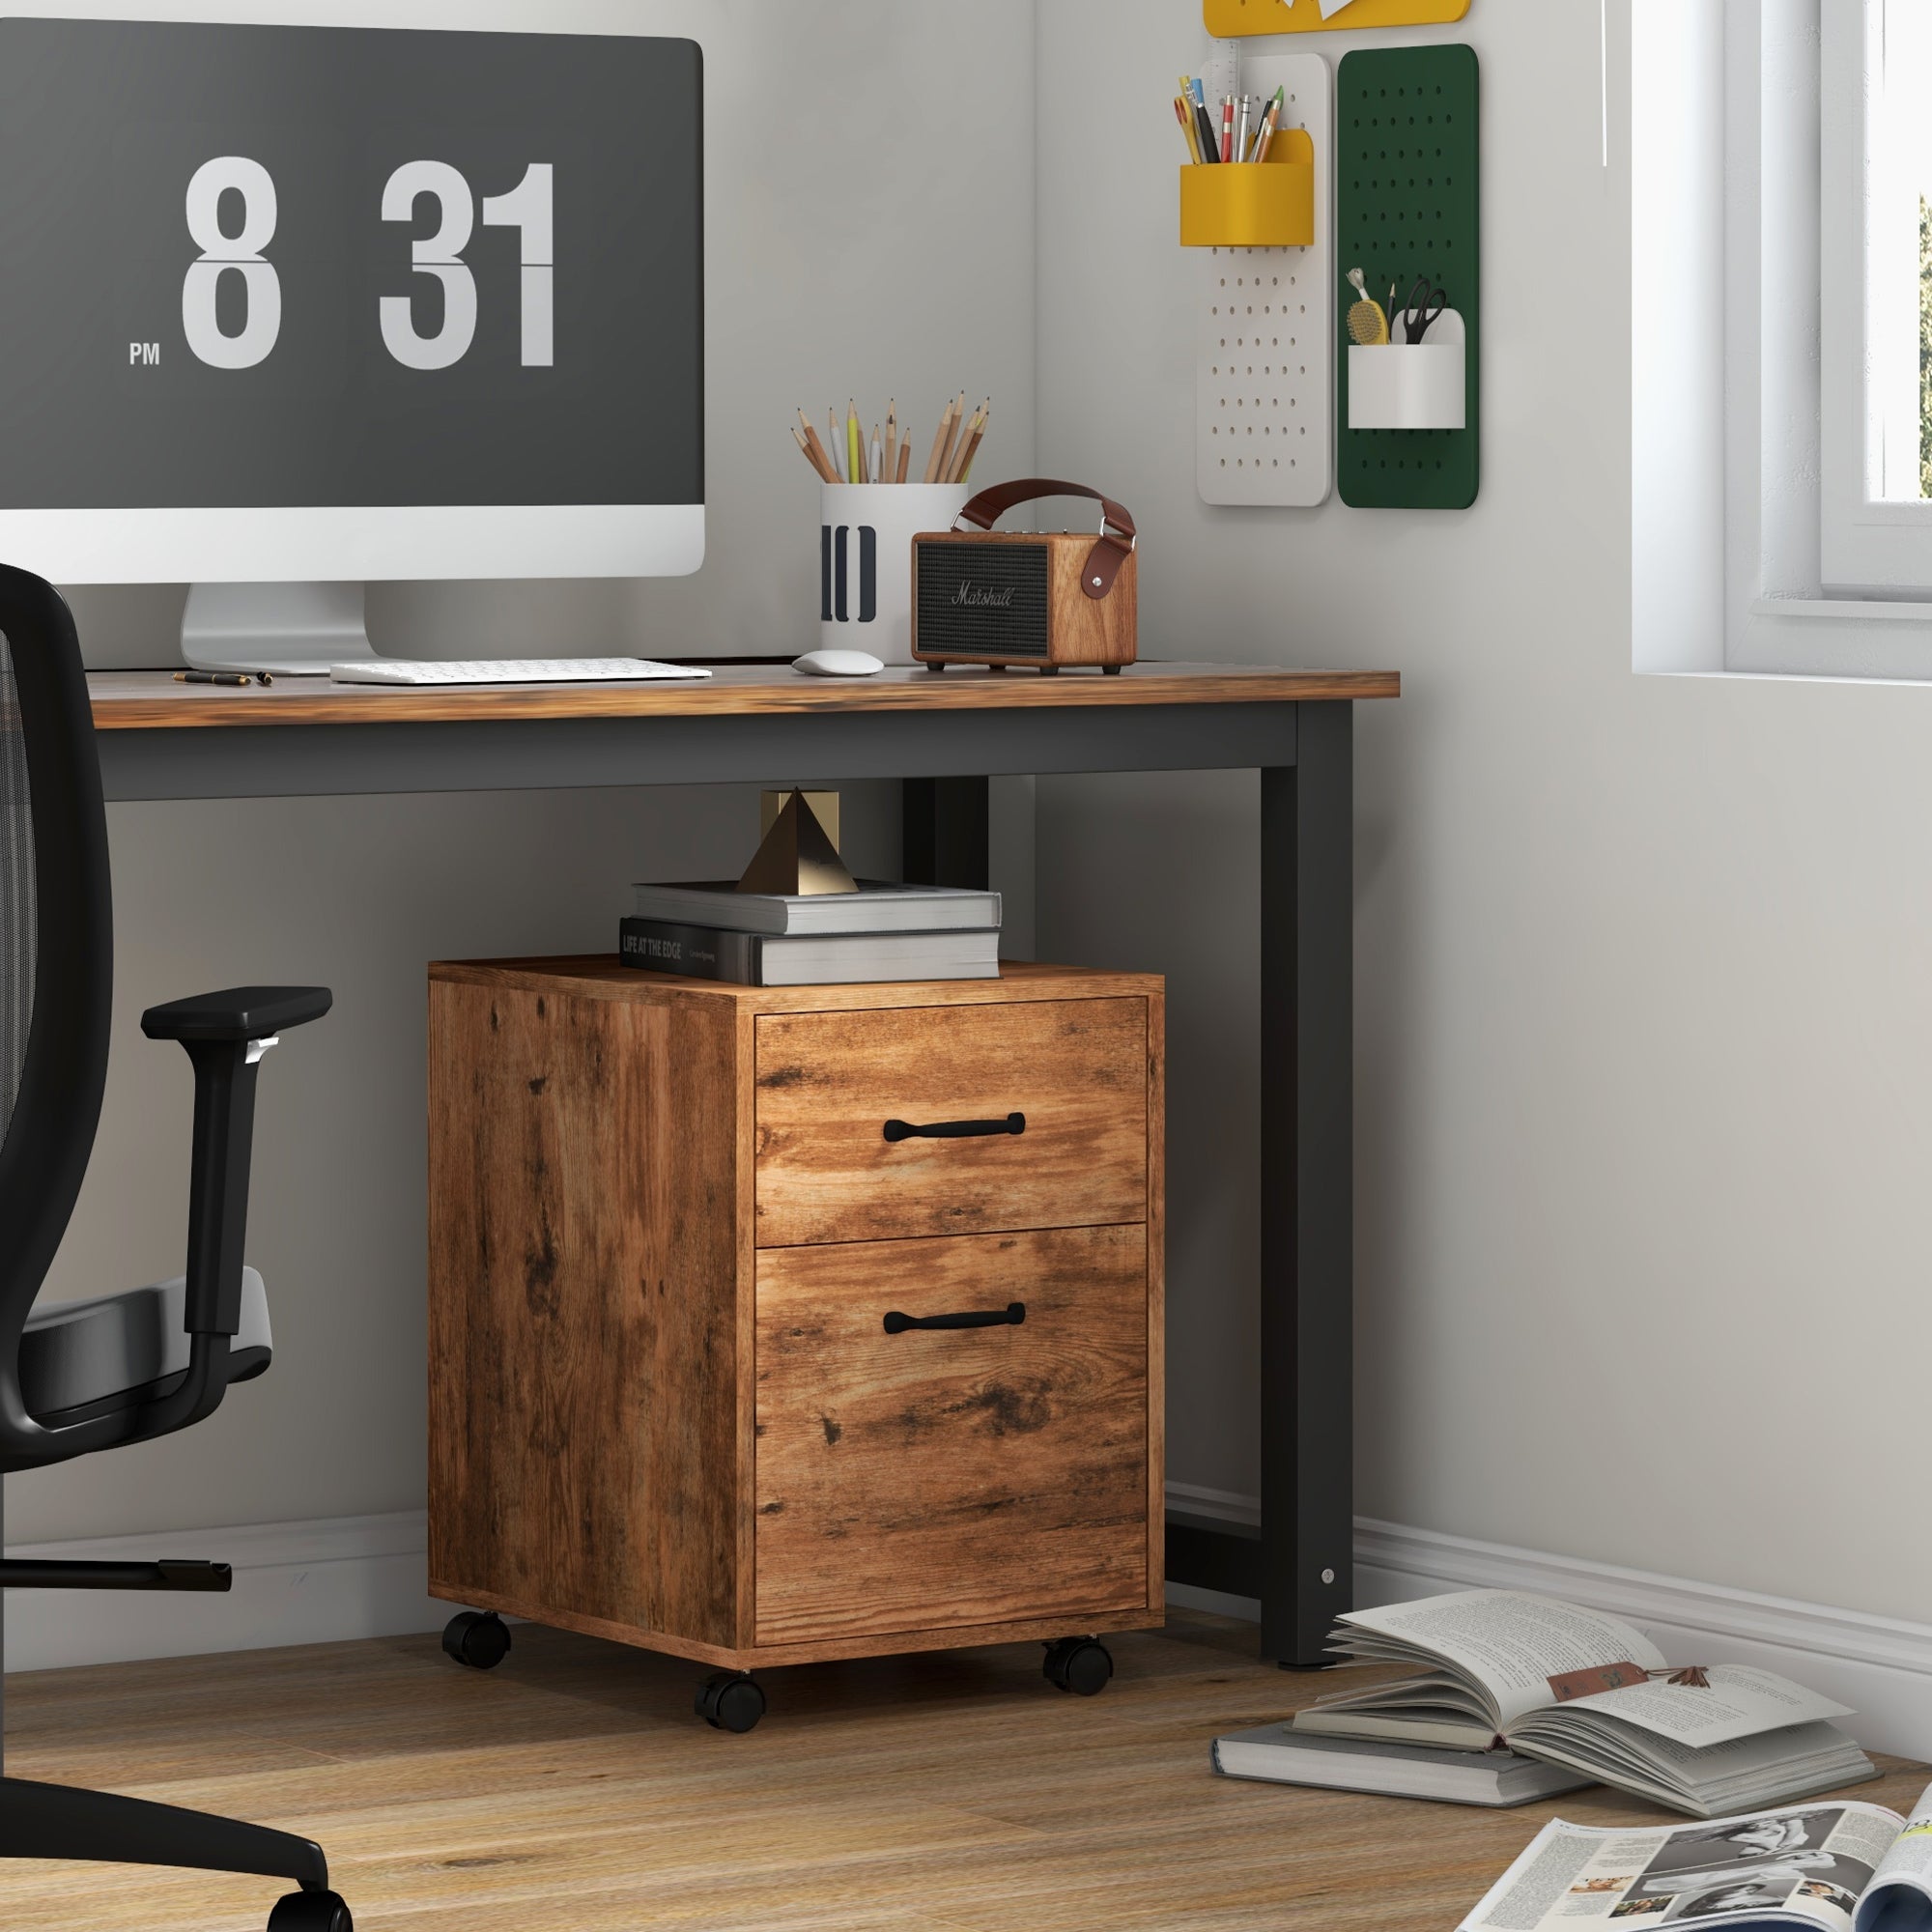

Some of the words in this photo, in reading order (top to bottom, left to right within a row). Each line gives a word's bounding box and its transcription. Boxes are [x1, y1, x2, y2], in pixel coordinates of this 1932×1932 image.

[129, 342, 160, 365] PM
[182, 156, 282, 370] 8
[379, 159, 554, 370] 31
[951, 579, 1015, 607] Marshall
[623, 934, 638, 953] LIFE
[638, 936, 647, 955] AT
[648, 938, 662, 957] THE
[663, 940, 682, 960] EDGE
